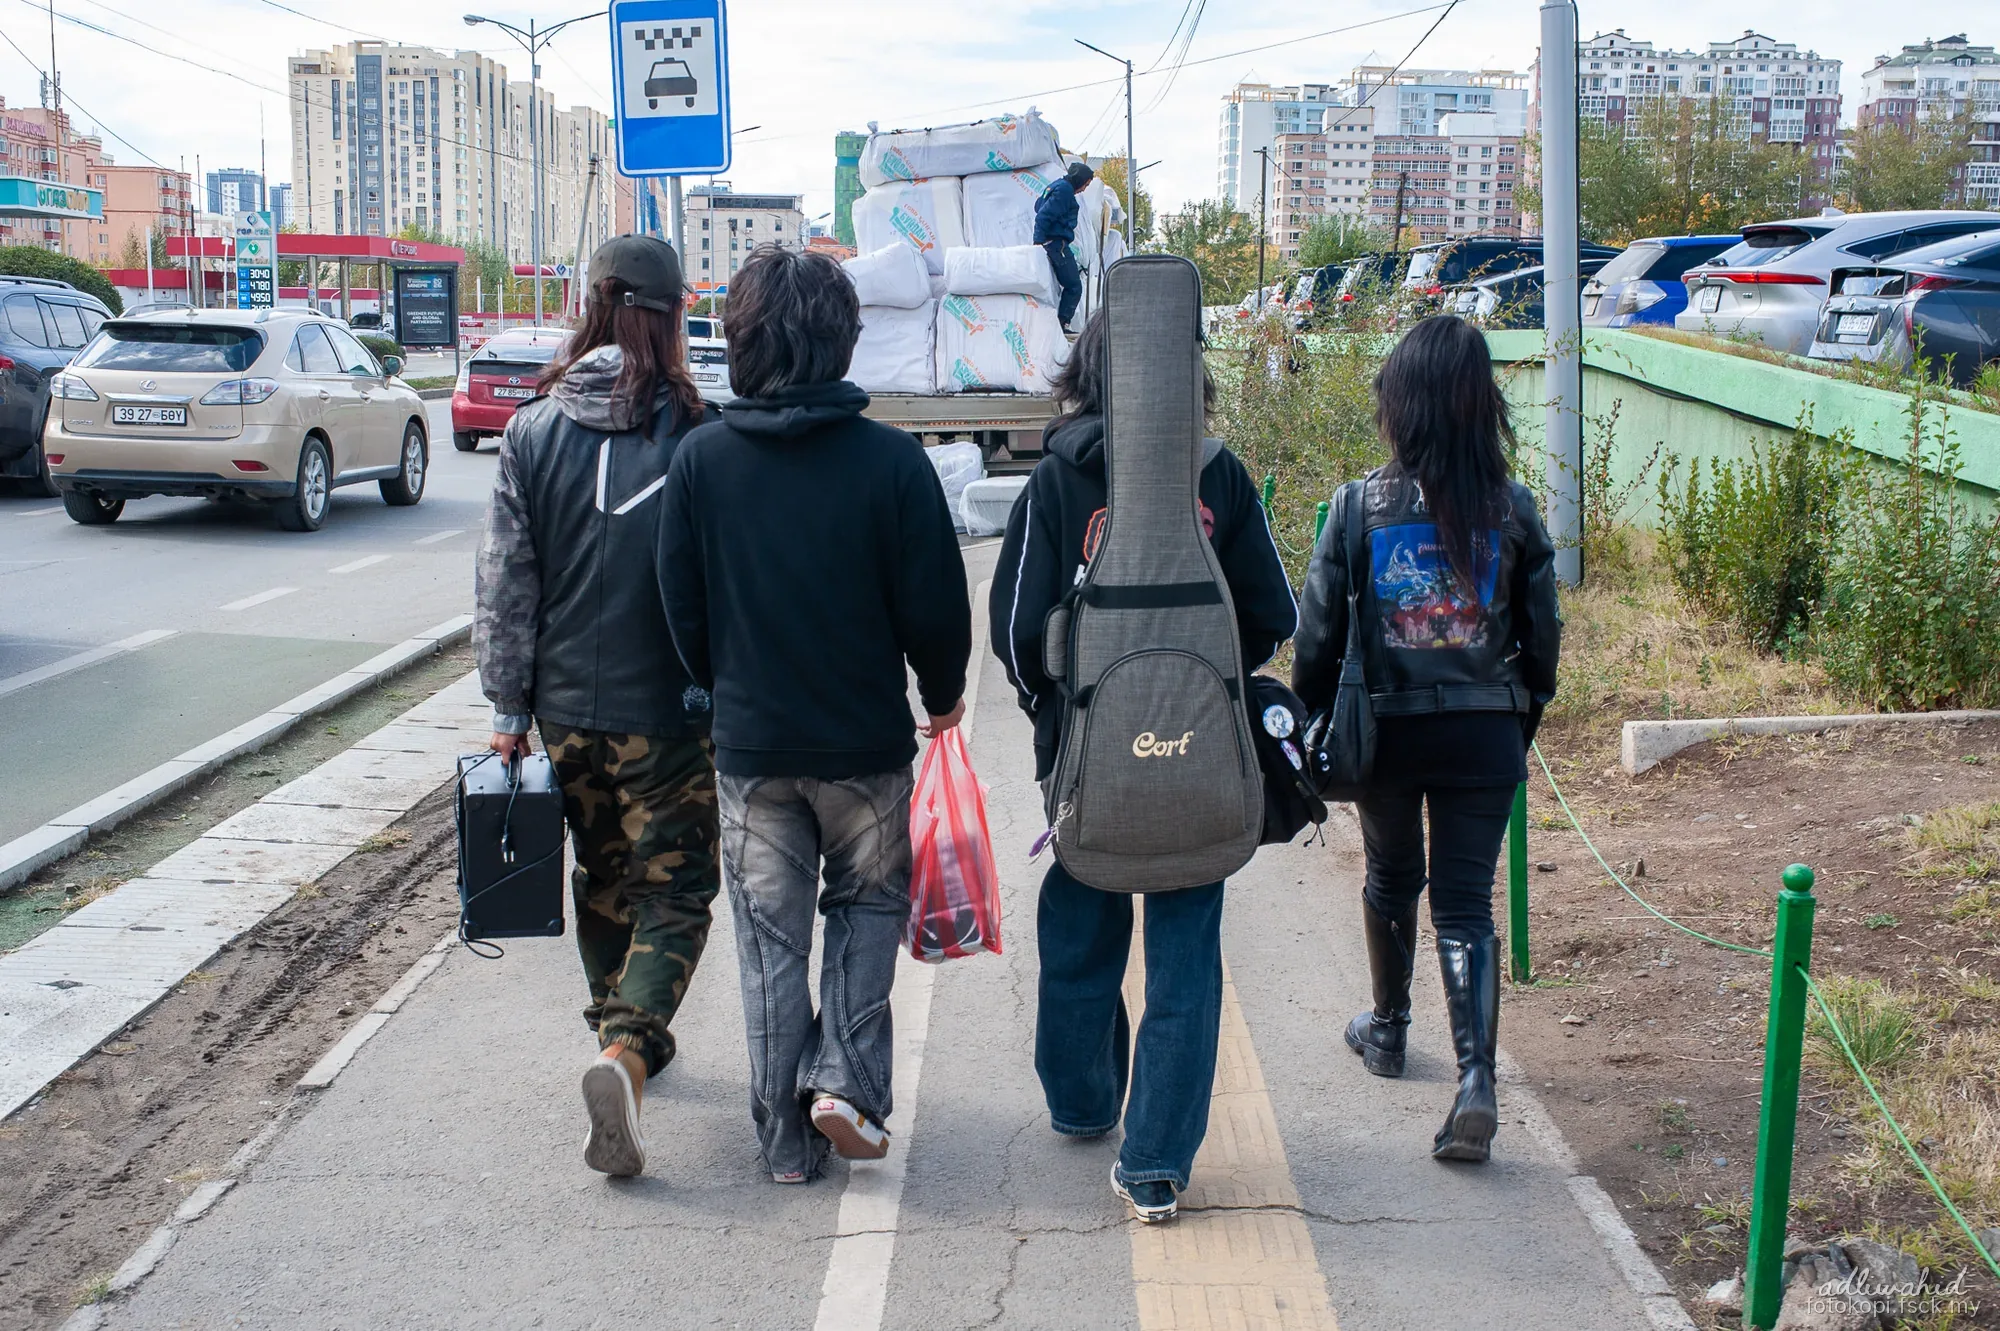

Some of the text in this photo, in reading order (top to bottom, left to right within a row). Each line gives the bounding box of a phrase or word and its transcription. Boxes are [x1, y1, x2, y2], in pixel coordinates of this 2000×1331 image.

[250, 269, 270, 279] 3040
[250, 281, 270, 291] 4780
[250, 293, 271, 303] 4950
[498, 388, 507, 396] 27
[508, 388, 517, 396] 85
[119, 408, 134, 420] 39
[138, 408, 152, 421] 27
[1132, 730, 1195, 758] Cort
